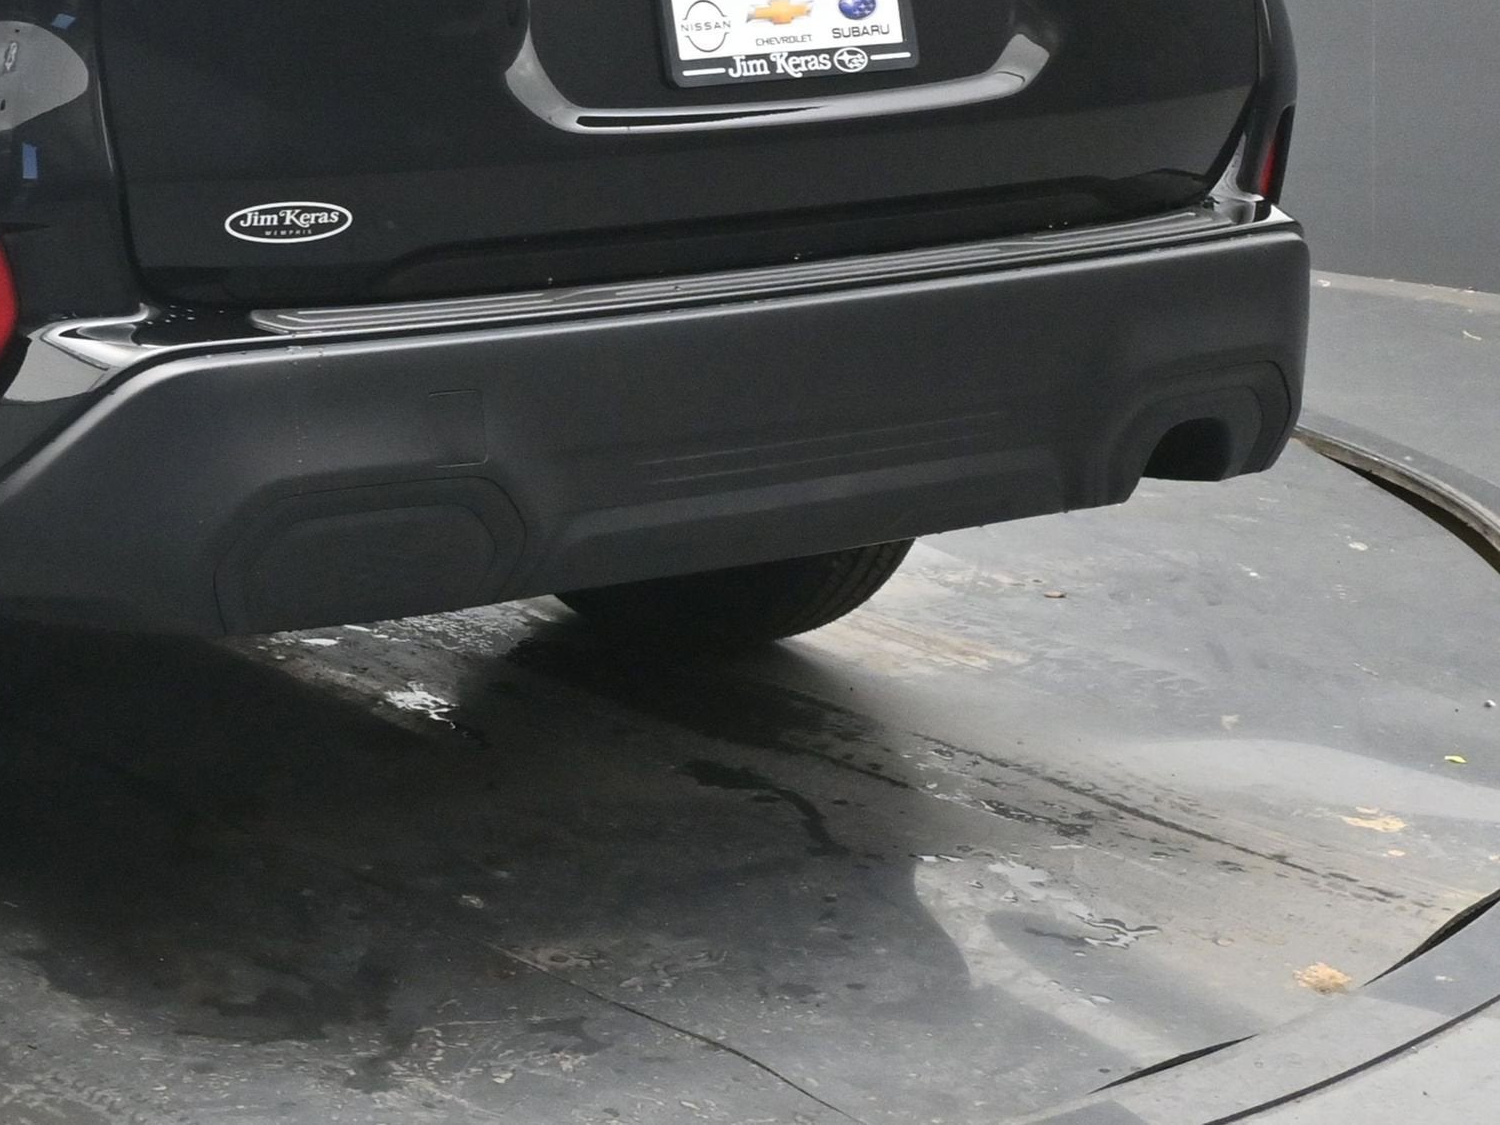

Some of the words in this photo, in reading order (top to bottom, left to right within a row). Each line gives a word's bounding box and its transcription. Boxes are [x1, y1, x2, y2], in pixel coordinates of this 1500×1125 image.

[680, 19, 732, 32] NISSAN
[831, 24, 890, 40] SUBARU
[755, 33, 813, 47] CHEVROLET
[728, 54, 771, 79] Jim
[771, 50, 832, 79] Keras
